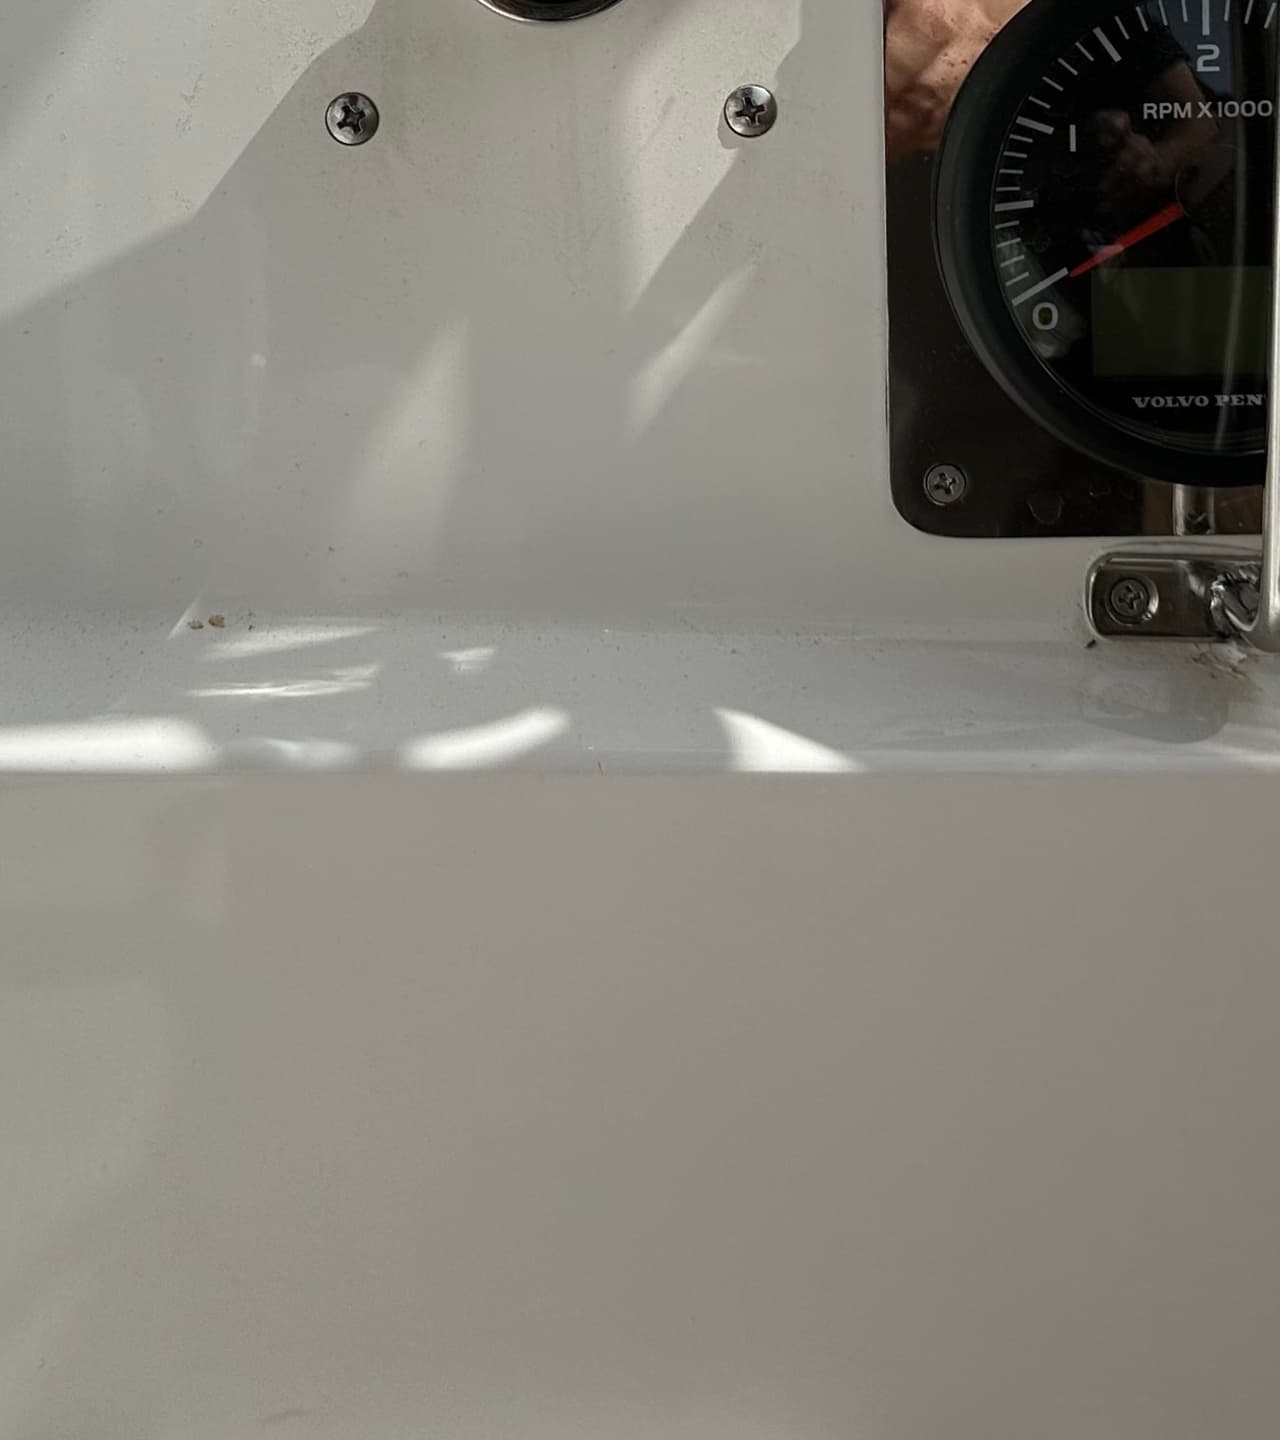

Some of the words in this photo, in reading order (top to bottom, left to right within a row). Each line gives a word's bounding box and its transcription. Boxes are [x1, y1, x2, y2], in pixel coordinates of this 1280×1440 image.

[1195, 43, 1221, 73] 2
[1142, 101, 1192, 121] RPM
[1196, 100, 1214, 119] X
[1031, 301, 1060, 331] 0
[1131, 394, 1210, 409] VOLVO
[1213, 393, 1268, 407] PEN
